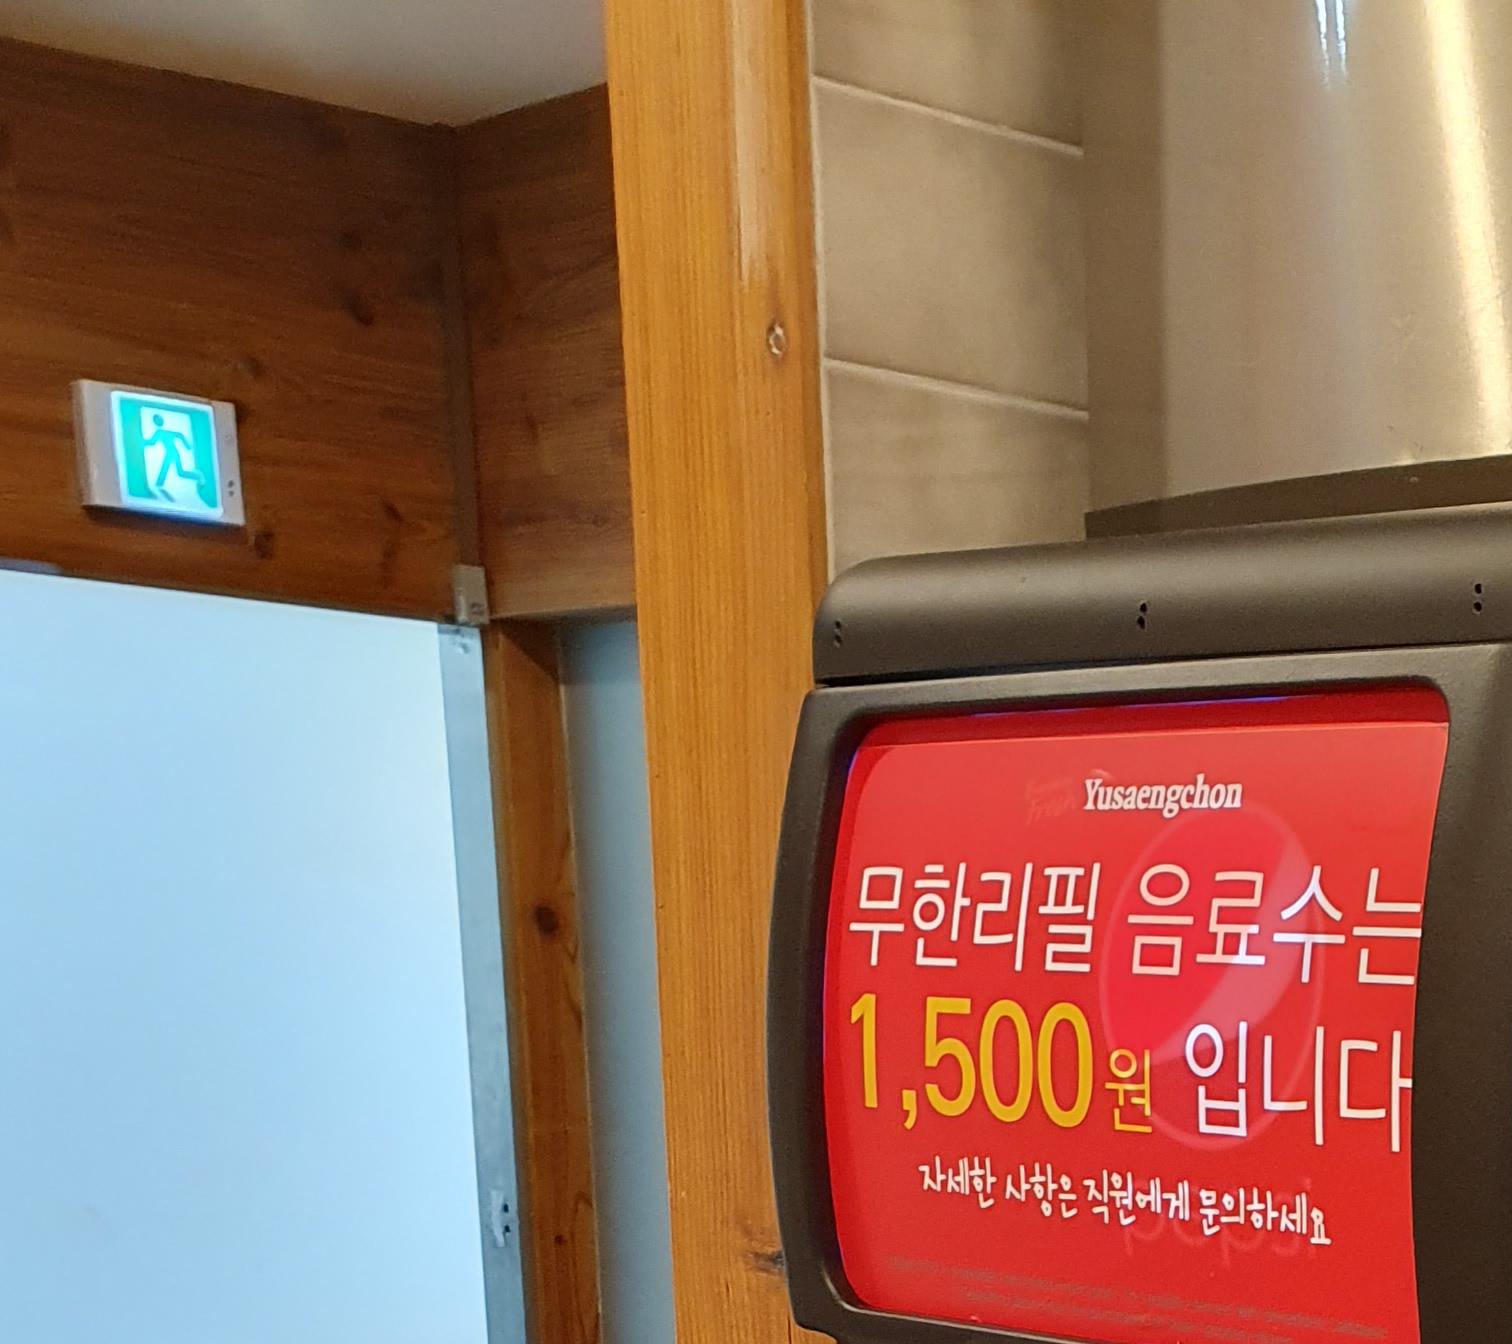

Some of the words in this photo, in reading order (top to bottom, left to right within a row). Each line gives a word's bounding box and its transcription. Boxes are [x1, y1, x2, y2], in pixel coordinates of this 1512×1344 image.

[1083, 773, 1242, 818] Yusaengchon
[849, 861, 1101, 972] 무한리필
[1127, 863, 1422, 985] 음료수는
[1186, 1021, 1413, 1153] 입니다
[918, 1155, 997, 1210] 자세한
[1004, 1163, 1078, 1218] 사항은
[1082, 1168, 1191, 1226] 직원에게
[1199, 1187, 1332, 1246] 문의하세요
